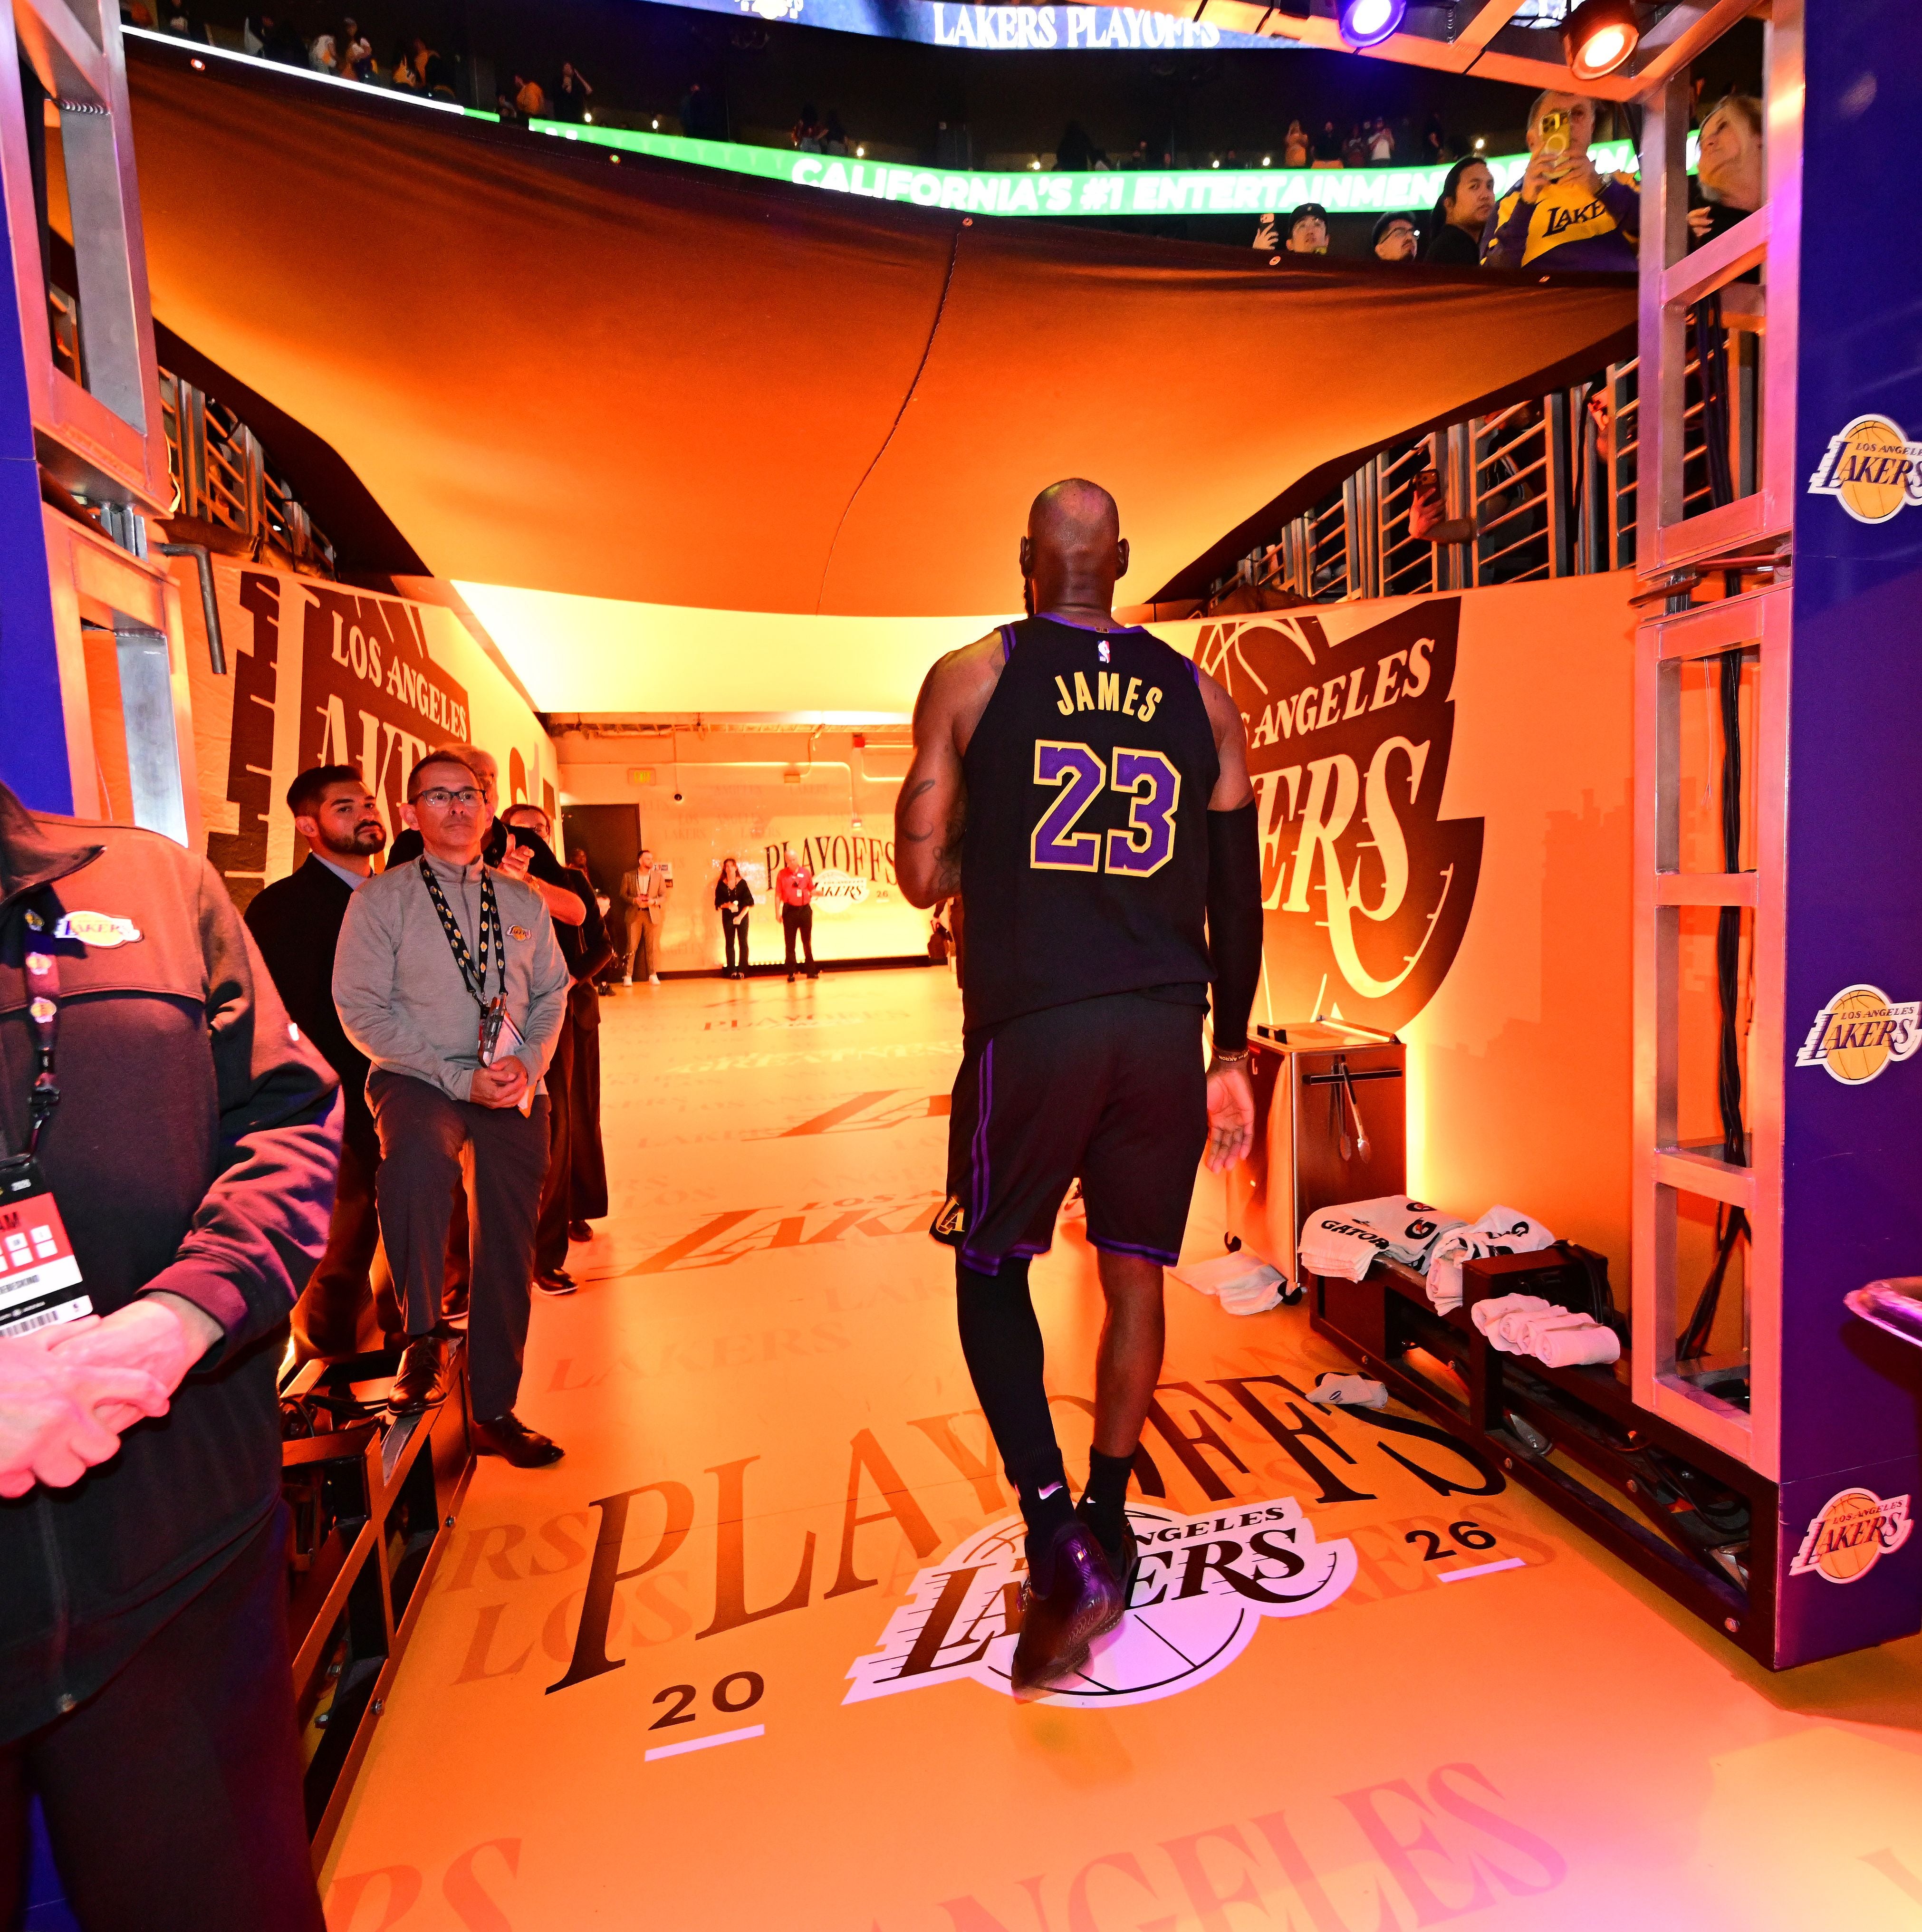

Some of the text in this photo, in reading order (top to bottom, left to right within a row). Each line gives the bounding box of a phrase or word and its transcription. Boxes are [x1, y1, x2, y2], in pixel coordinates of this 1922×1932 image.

[932, 3, 1220, 48] LAKERS PLAYOFFS
[791, 159, 1073, 211] CALIFORNIA'S
[1080, 177, 1124, 210] #1
[1855, 442, 1877, 452] LOS
[332, 610, 467, 743] LOS ANGELES
[1055, 671, 1163, 722] JAMES
[1251, 637, 1435, 750] ANGELES
[1030, 739, 1182, 877] 23
[1251, 736, 1453, 998] ERS
[1802, 1013, 1917, 1061] LAKERS
[1841, 1006, 1915, 1019] LOS ANGELES
[798, 1193, 897, 1211] LOS
[1133, 1507, 1285, 1546] NGELES
[1832, 1499, 1904, 1524] LOS ANGELES
[1405, 1520, 1497, 1562] 26
[1796, 1512, 1907, 1569] LAKERS
[873, 1527, 1336, 1683] LAERS
[647, 1671, 765, 1731] 20
[865, 1761, 1567, 1932] GELES
